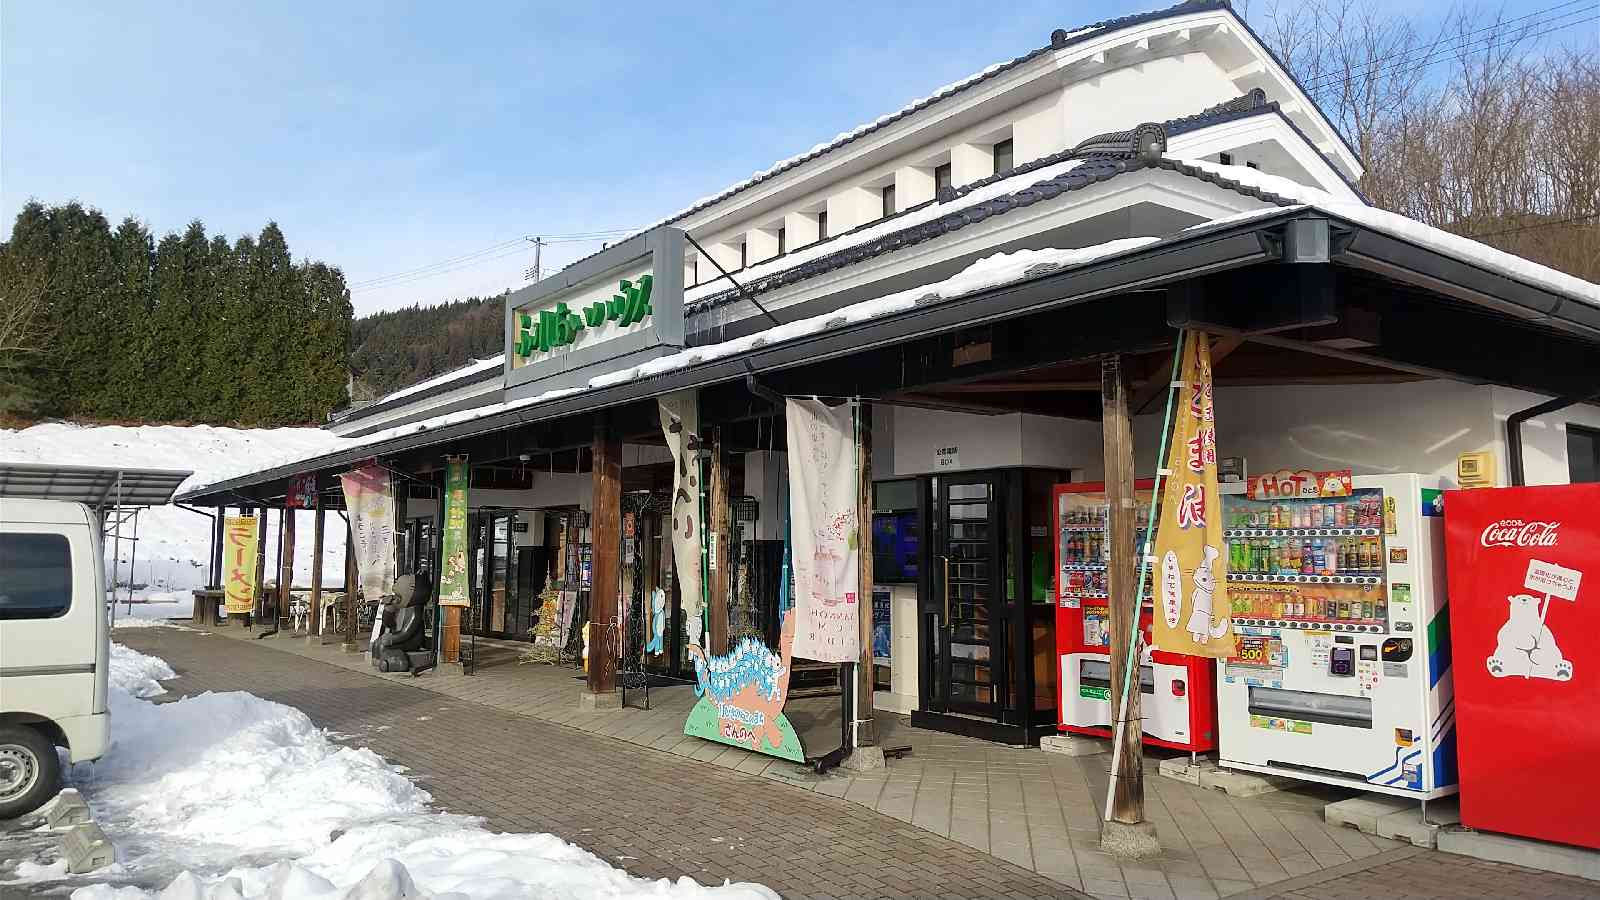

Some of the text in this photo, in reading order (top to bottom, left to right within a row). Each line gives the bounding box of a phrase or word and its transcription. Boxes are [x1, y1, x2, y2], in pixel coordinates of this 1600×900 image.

[1263, 475, 1307, 497] HOT
[1481, 521, 1560, 548] Coca-Cola
[228, 528, 252, 603] ラーメン
[725, 724, 756, 742] さんのへ
